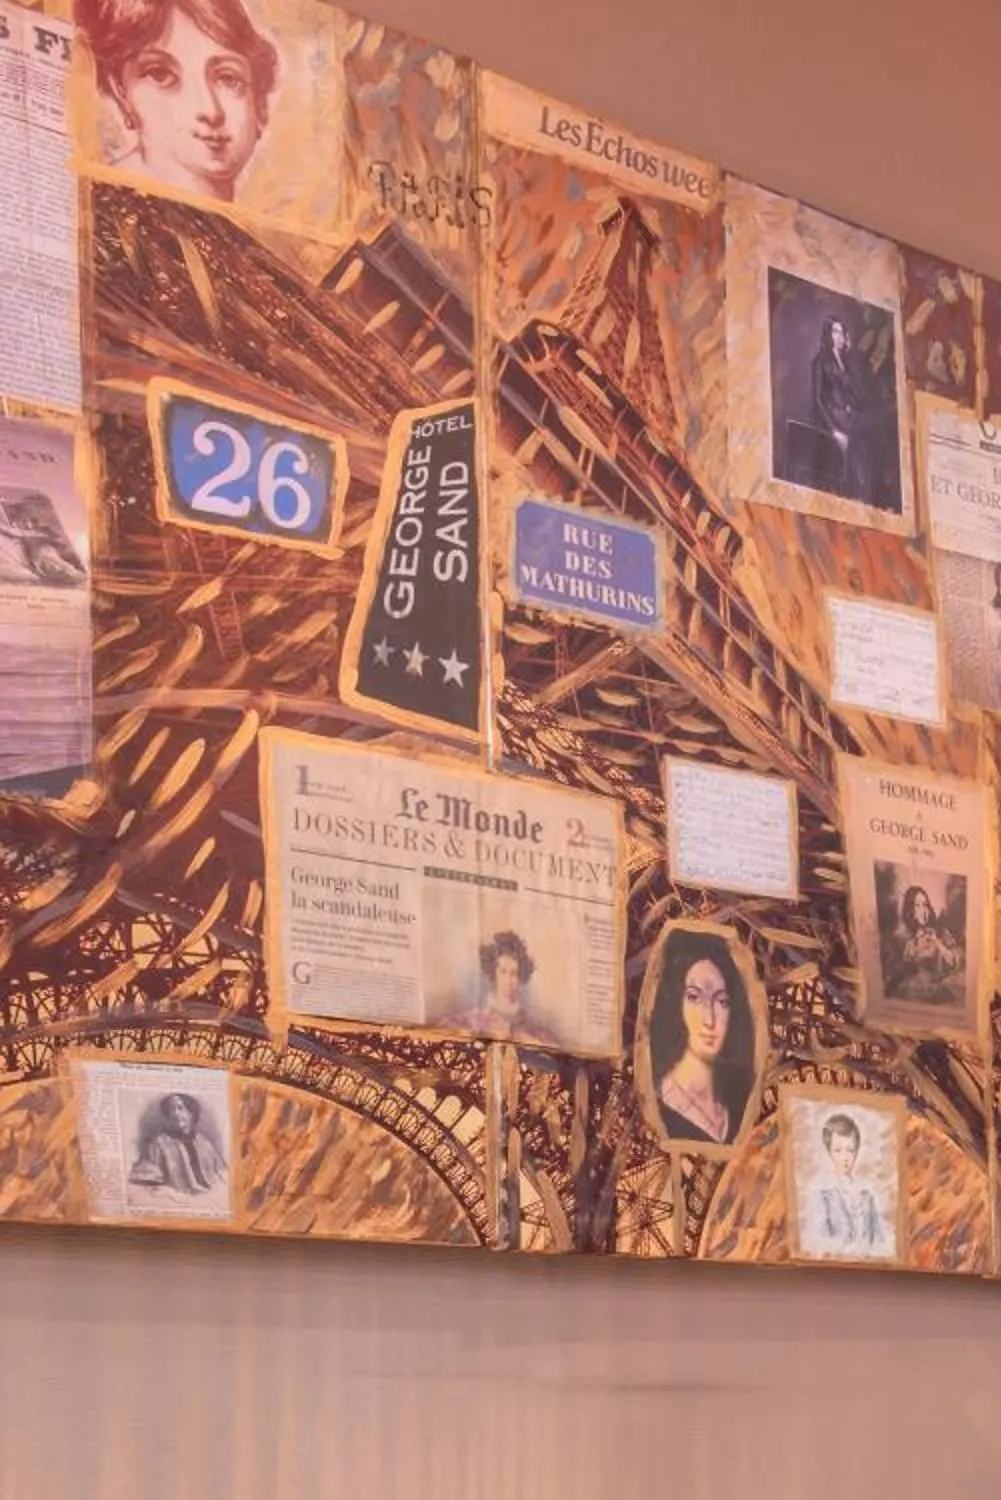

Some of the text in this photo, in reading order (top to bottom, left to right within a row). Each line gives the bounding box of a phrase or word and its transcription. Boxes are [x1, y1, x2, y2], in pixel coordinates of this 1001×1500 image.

[539, 106, 581, 147] Les
[191, 421, 311, 529] 26
[383, 446, 431, 619] GEORGE
[433, 461, 469, 583] SAND
[562, 523, 614, 556] RUE
[519, 564, 656, 607] MATHURINS
[564, 551, 613, 580] DES
[879, 779, 957, 811] HOMMAGE
[293, 807, 438, 853] DOSSIERS
[443, 831, 466, 859] &
[396, 788, 429, 821] Le
[435, 792, 543, 844] Monde
[869, 818, 968, 850] GEORGE SAND
[291, 866, 352, 894] George
[357, 877, 400, 900] Sand
[291, 890, 417, 925] la scandaleuse
